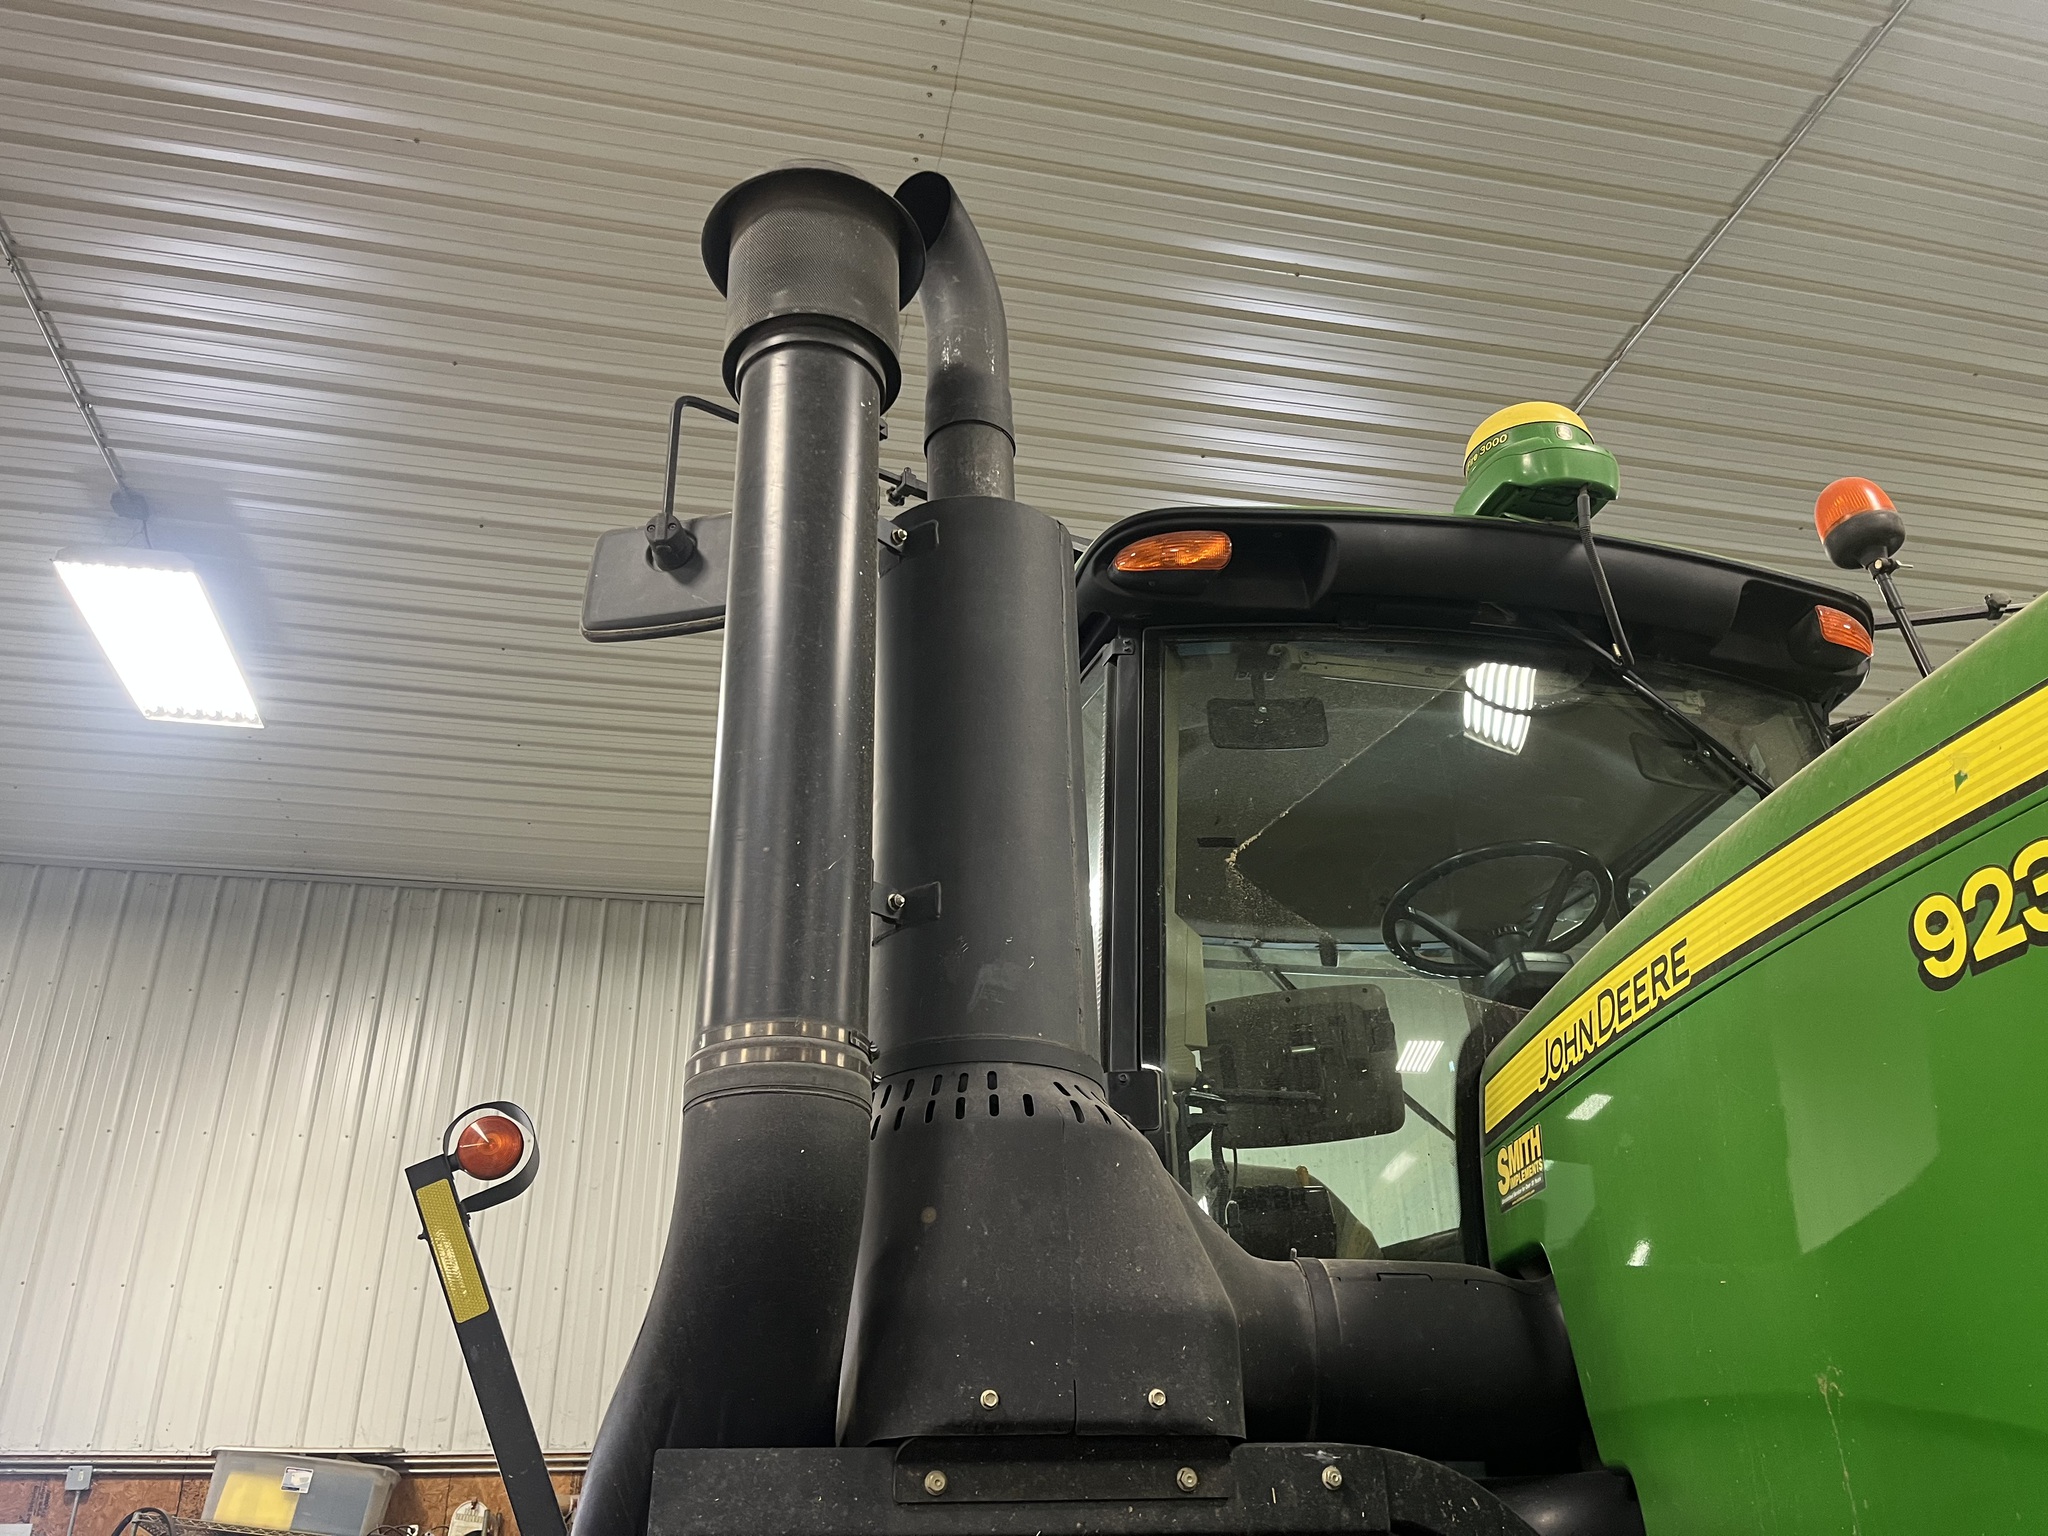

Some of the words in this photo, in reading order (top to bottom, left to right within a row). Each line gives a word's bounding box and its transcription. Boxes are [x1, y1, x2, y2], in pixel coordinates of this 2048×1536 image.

[1479, 433, 1508, 456] 3000
[1539, 1010, 1594, 1086] JOHN
[1597, 937, 1690, 1040] DEERE
[1497, 1123, 1542, 1196] SMITH
[1510, 1158, 1544, 1190] IMPLEMENTS
